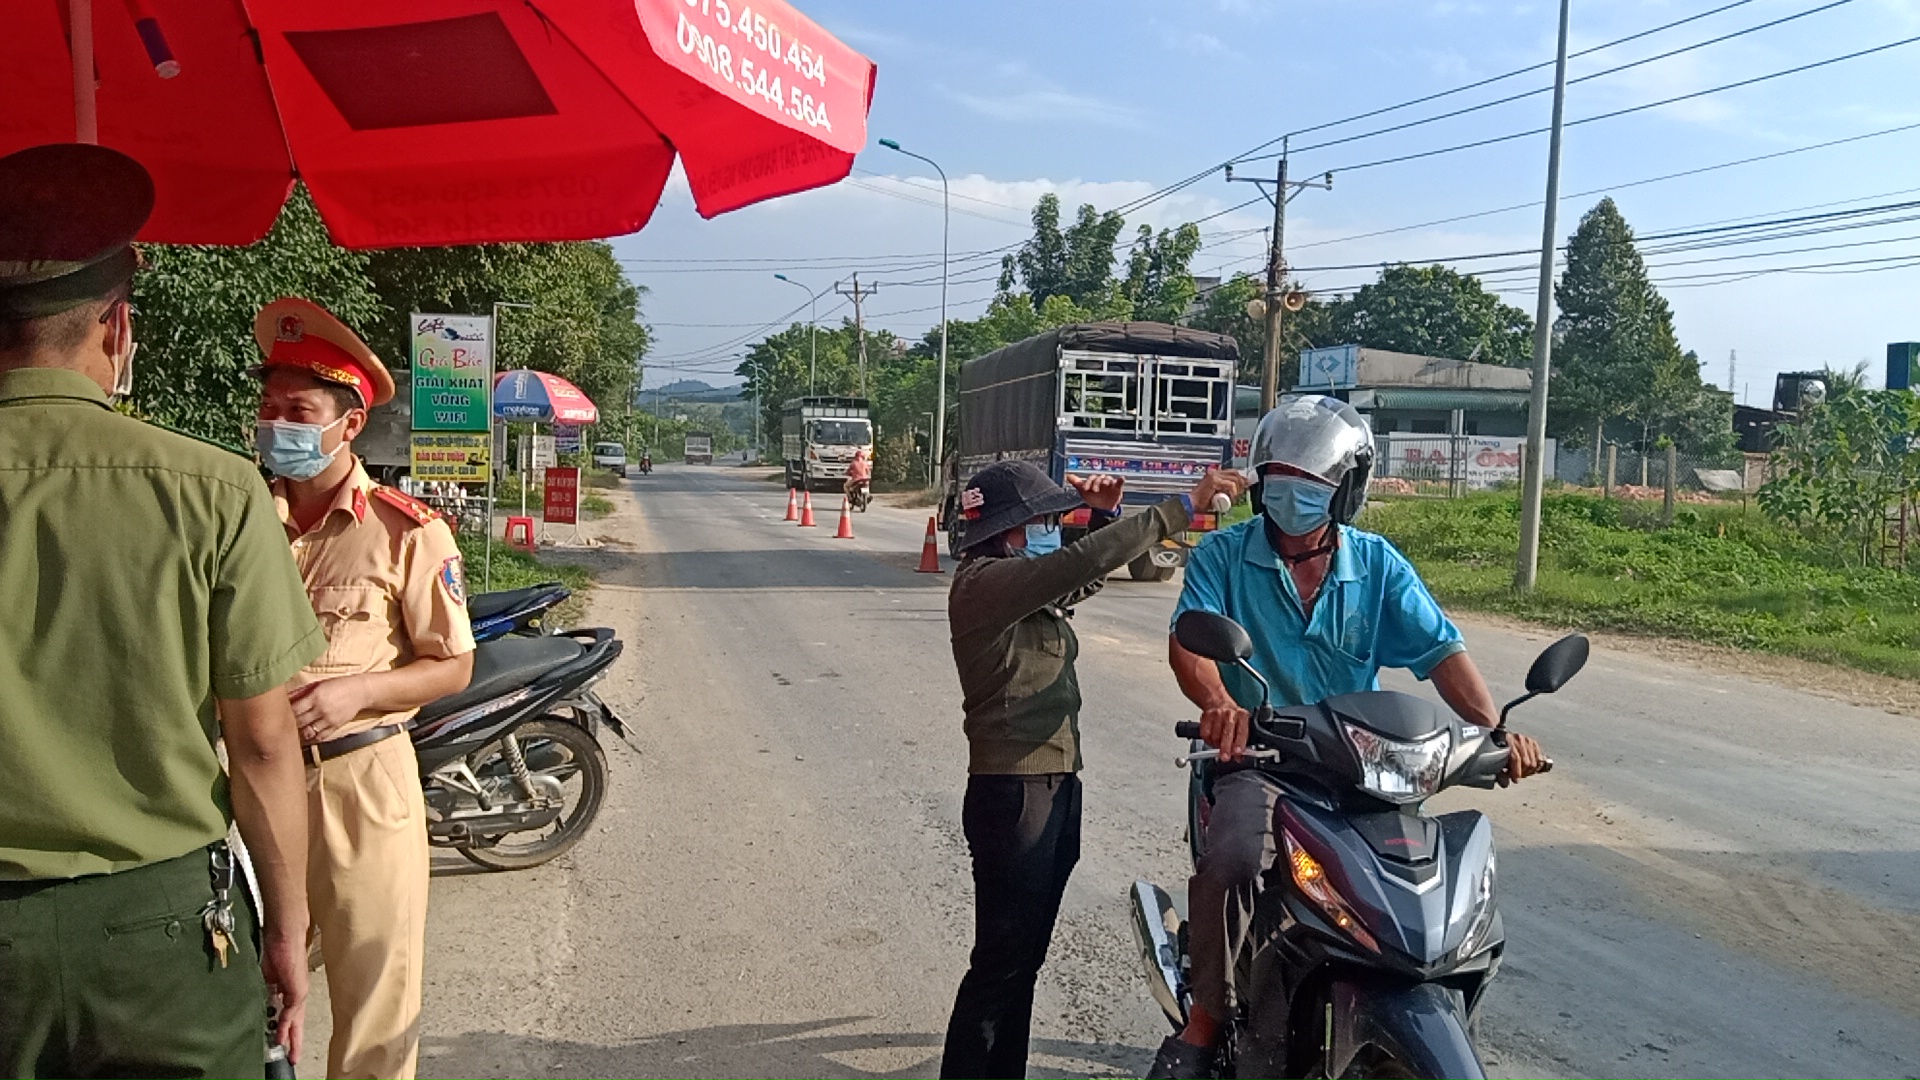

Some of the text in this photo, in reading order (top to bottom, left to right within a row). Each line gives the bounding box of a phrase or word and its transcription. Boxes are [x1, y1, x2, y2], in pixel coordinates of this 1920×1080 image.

[676, 12, 832, 133] 0908.544.564
[685, 0, 826, 87] 5.450.454
[434, 411, 467, 423] WIFI
